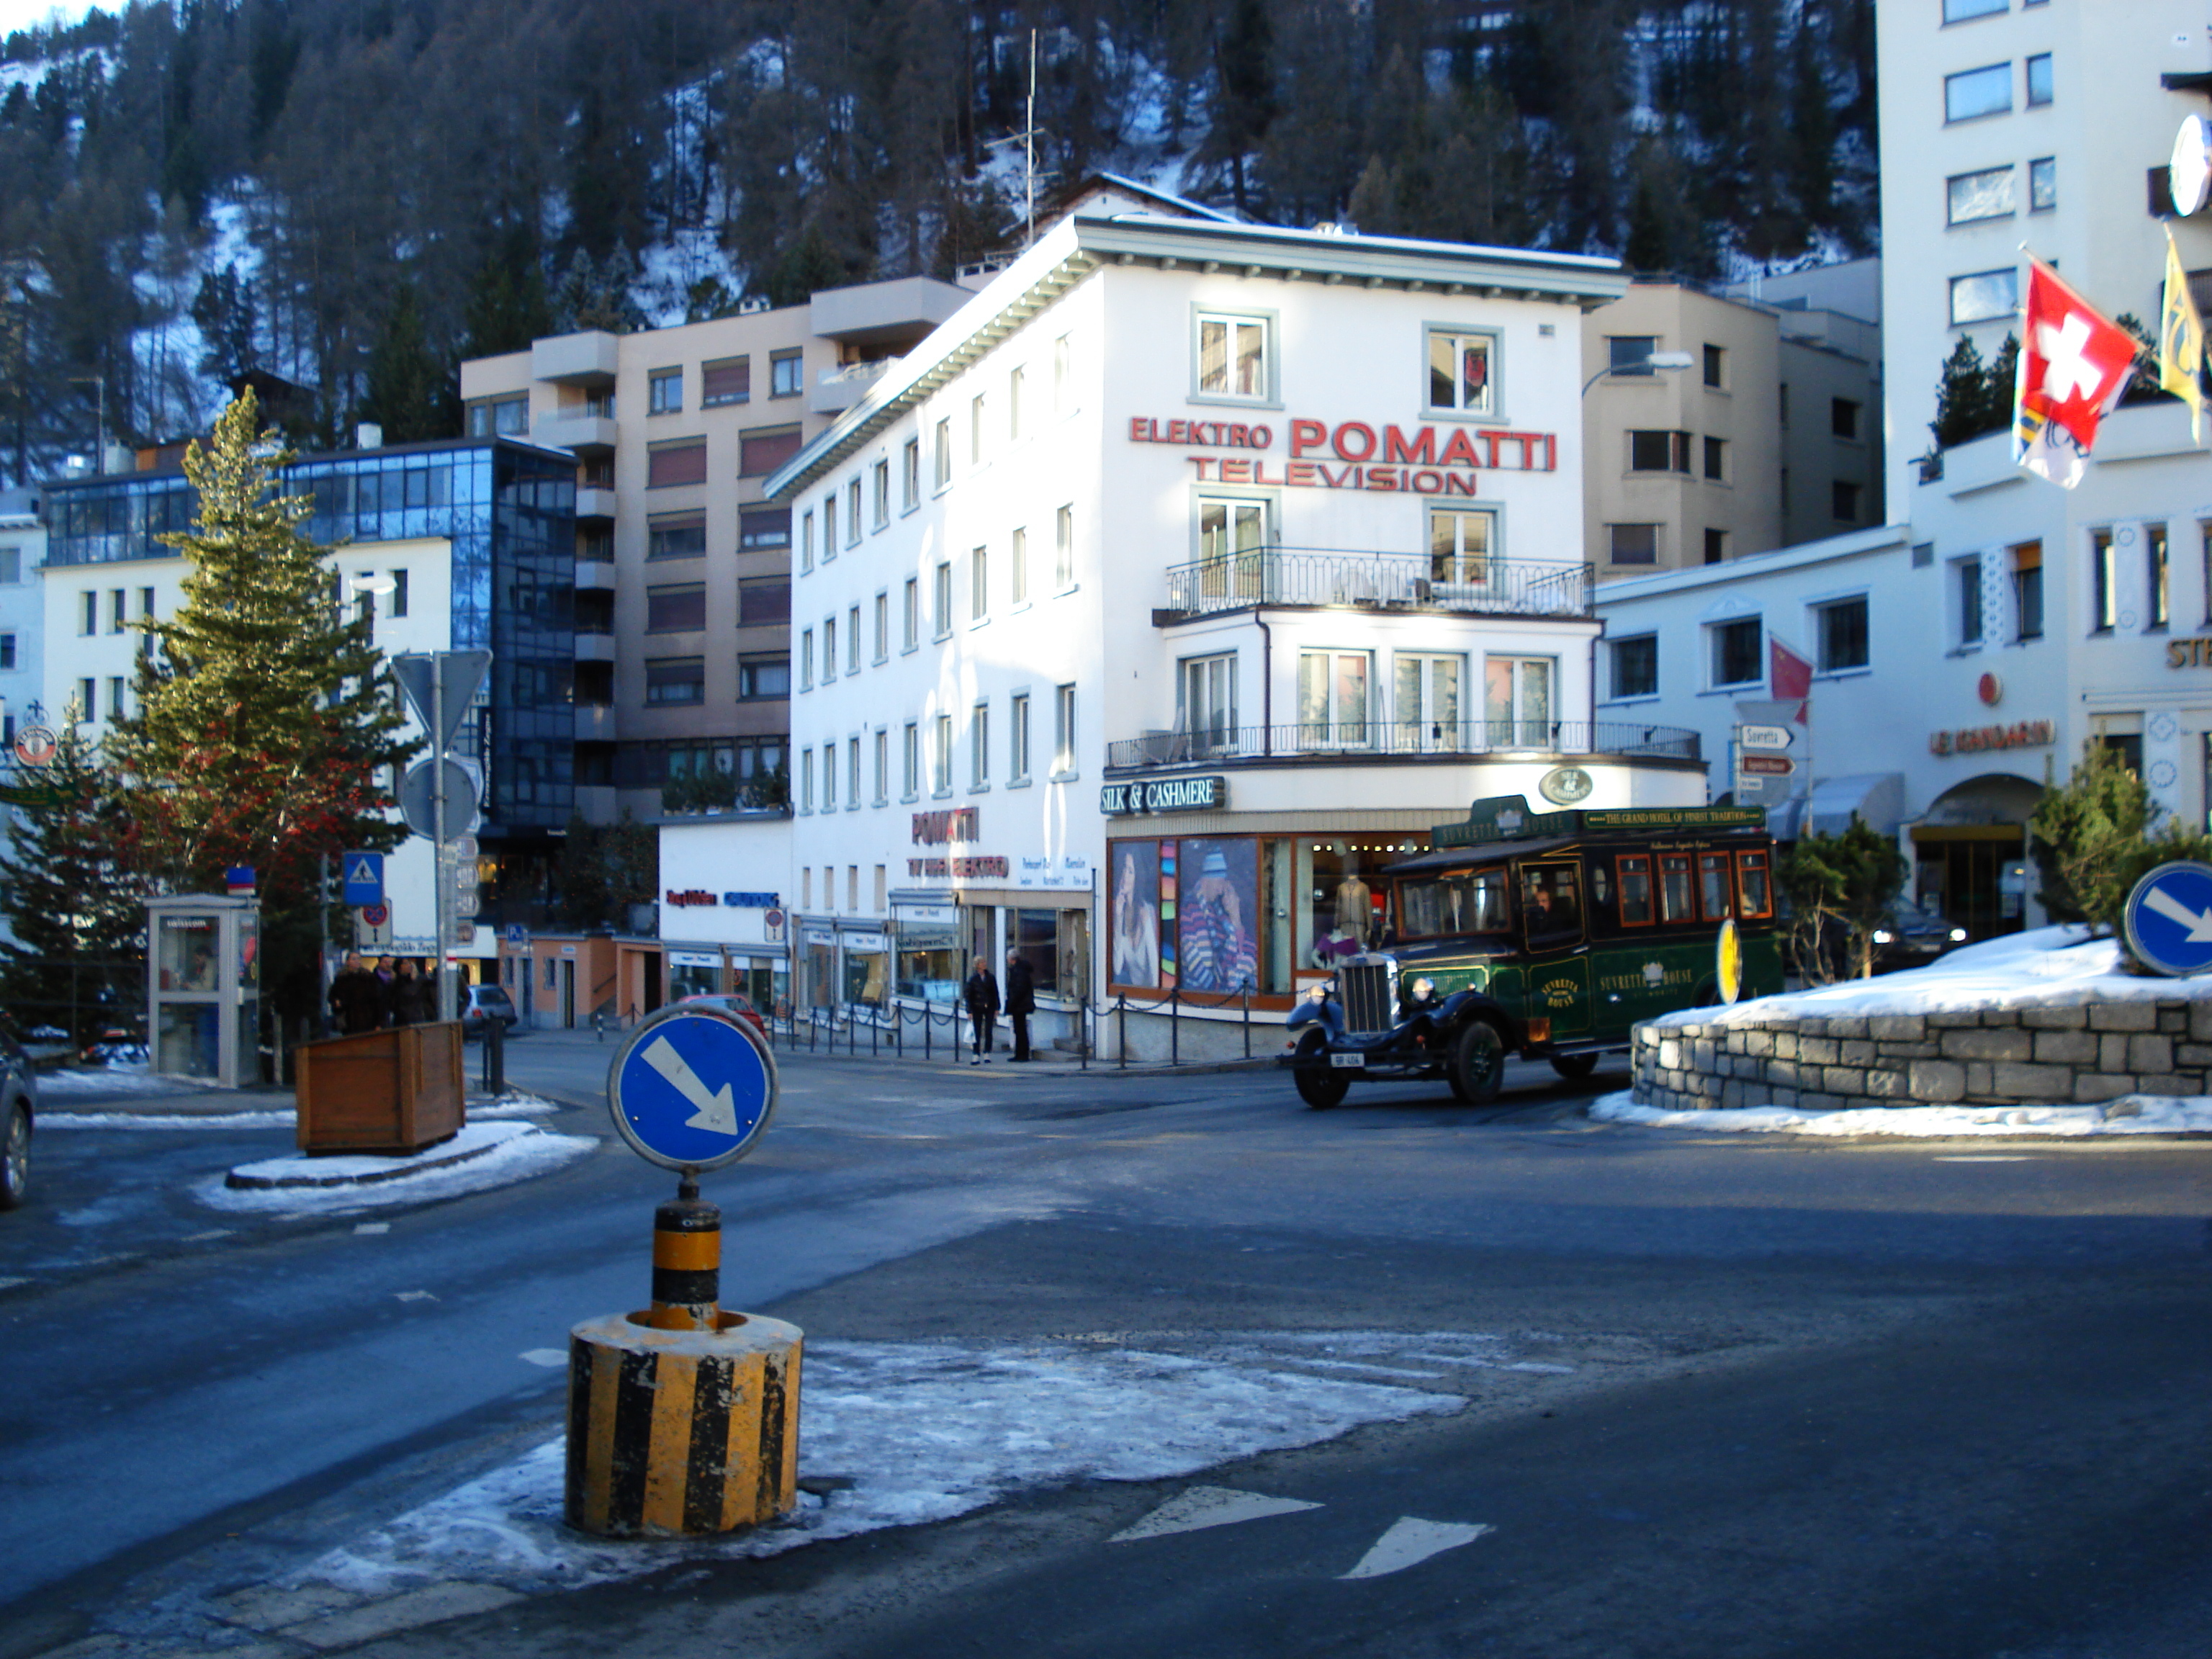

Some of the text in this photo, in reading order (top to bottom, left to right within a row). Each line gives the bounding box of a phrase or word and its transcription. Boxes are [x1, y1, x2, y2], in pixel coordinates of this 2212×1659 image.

[1130, 417, 1557, 471] ELEKTRO POMATTI
[1187, 457, 1476, 495] TELEVISION
[1101, 778, 1215, 811] SILK & CASHMERE
[1622, 812, 1648, 824] GRAND
[1650, 811, 1671, 823] HOTEL
